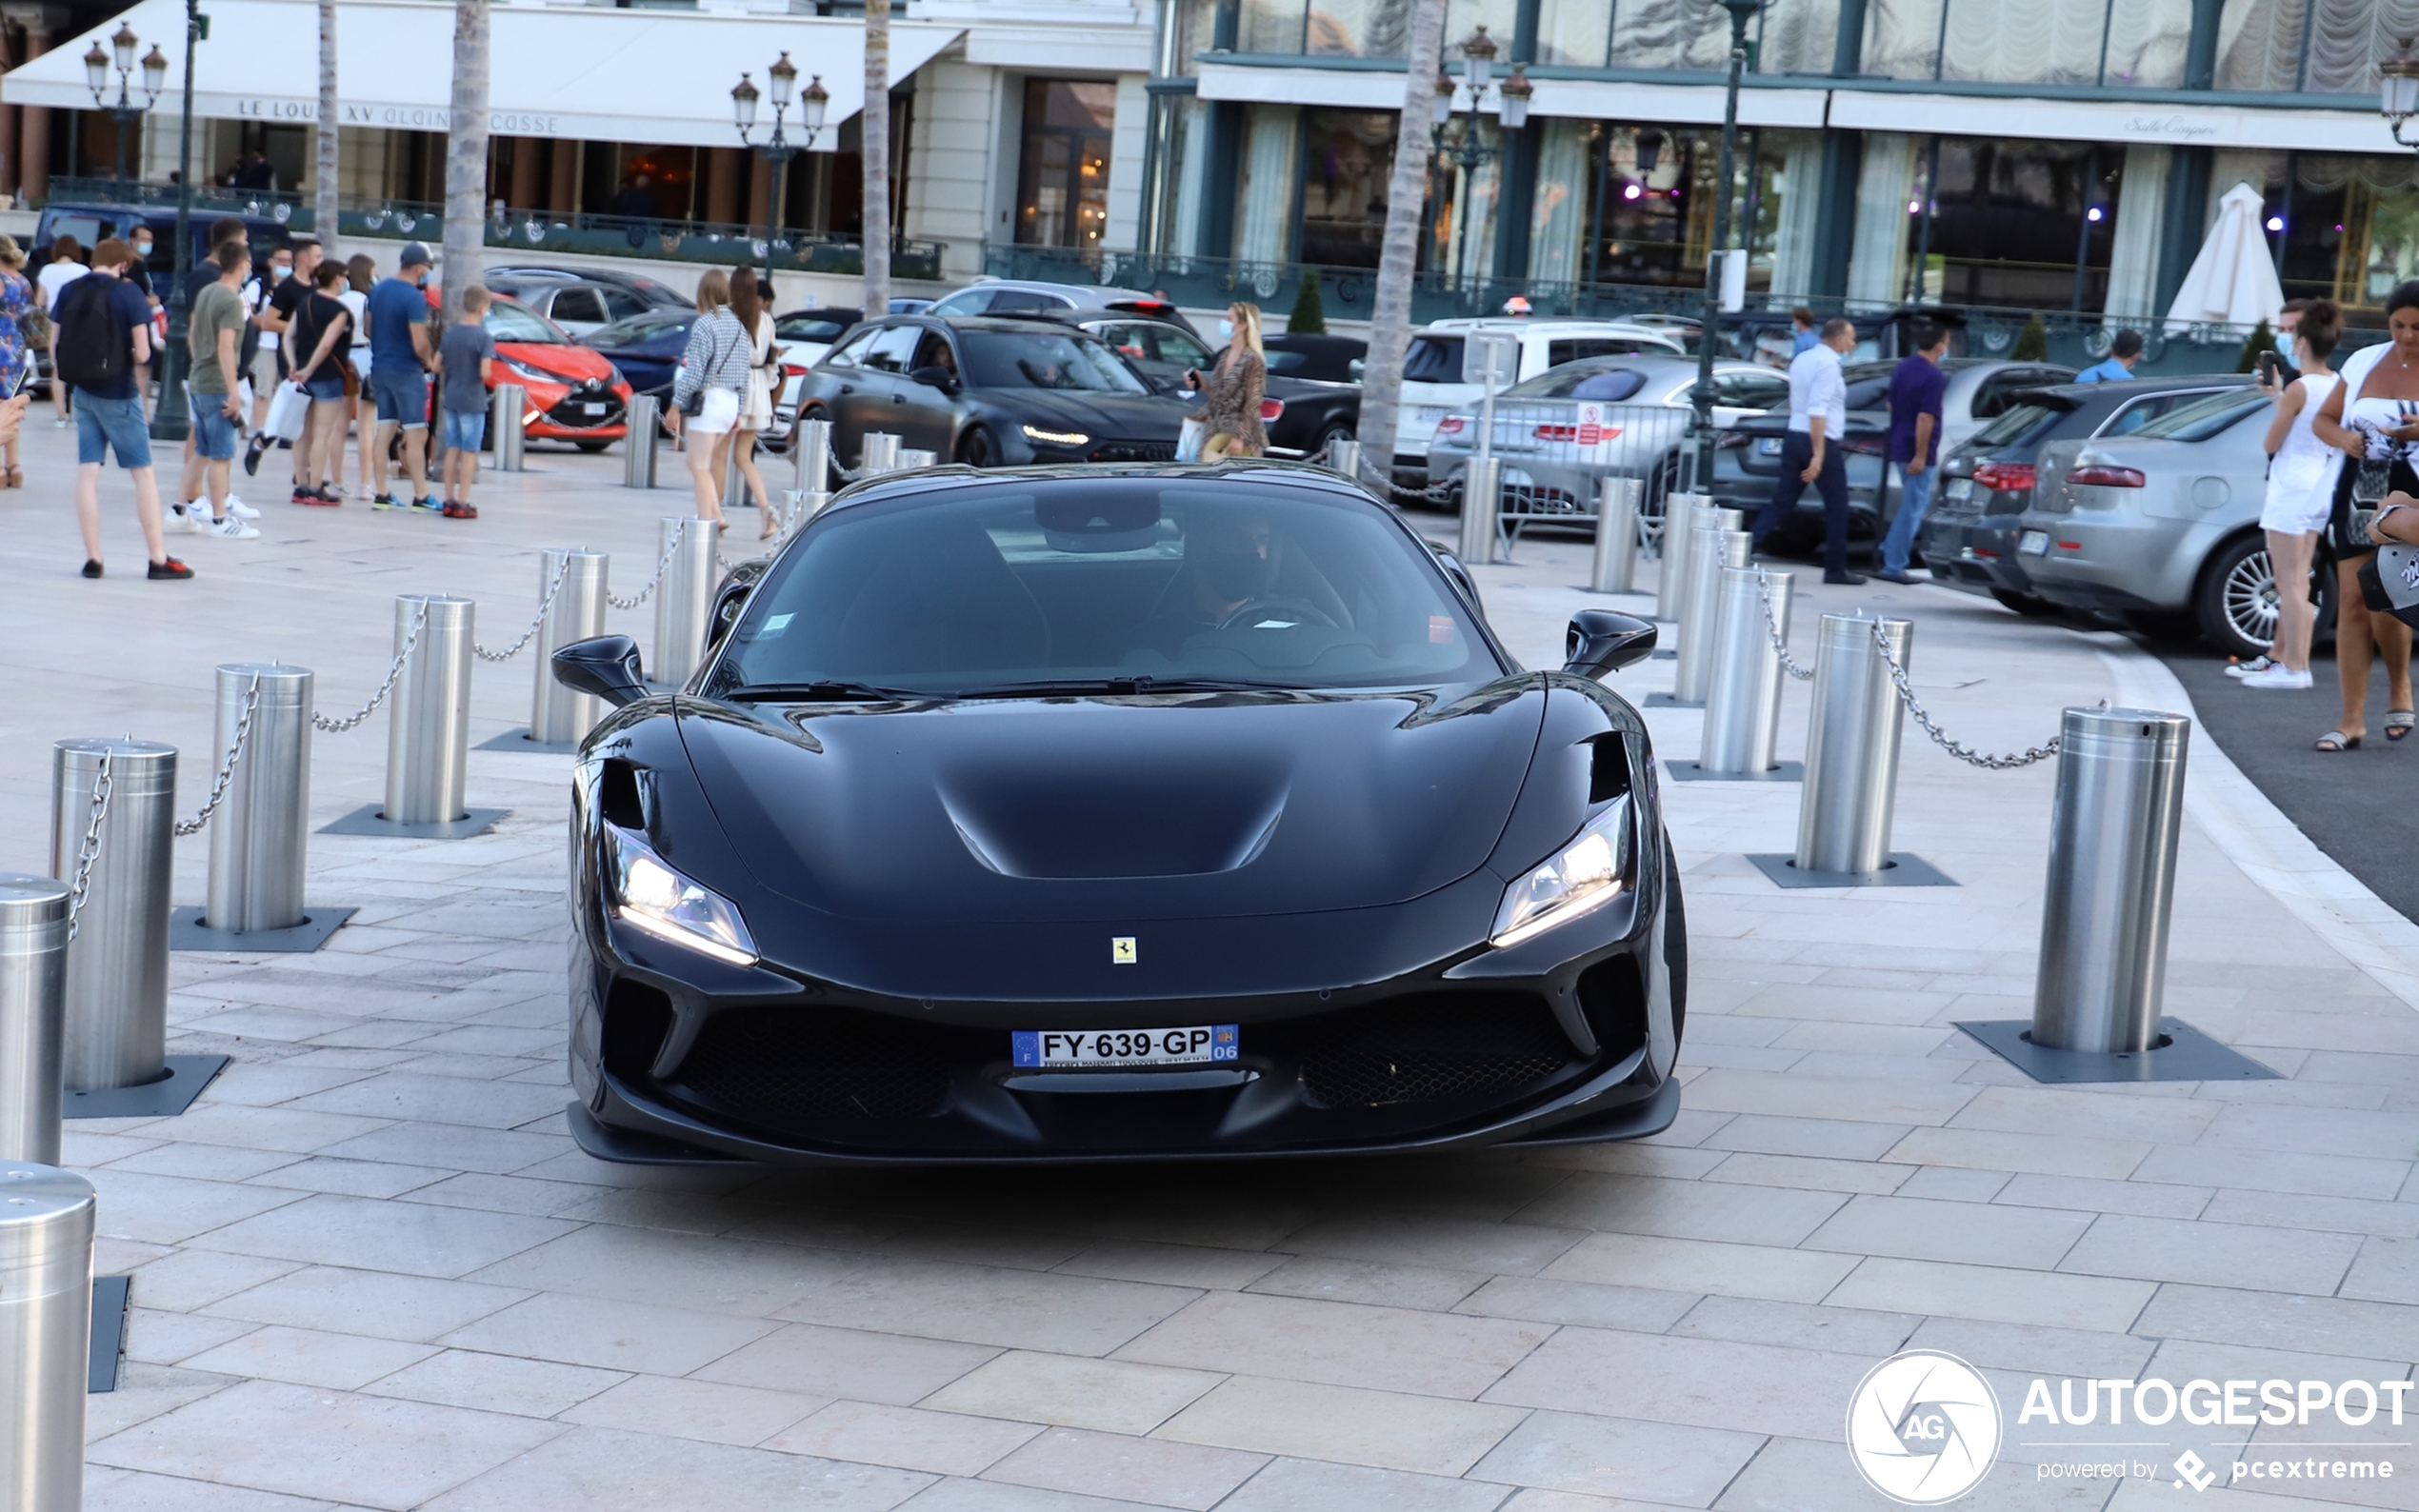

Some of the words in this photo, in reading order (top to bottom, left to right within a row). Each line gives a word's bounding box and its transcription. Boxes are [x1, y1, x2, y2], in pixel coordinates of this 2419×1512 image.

[240, 100, 262, 116] LE
[274, 102, 313, 118] LOU
[349, 105, 373, 122] XV
[1044, 1030, 1210, 1058] FY-639-GP
[1213, 1045, 1237, 1059] 06
[1024, 1053, 1031, 1062] F
